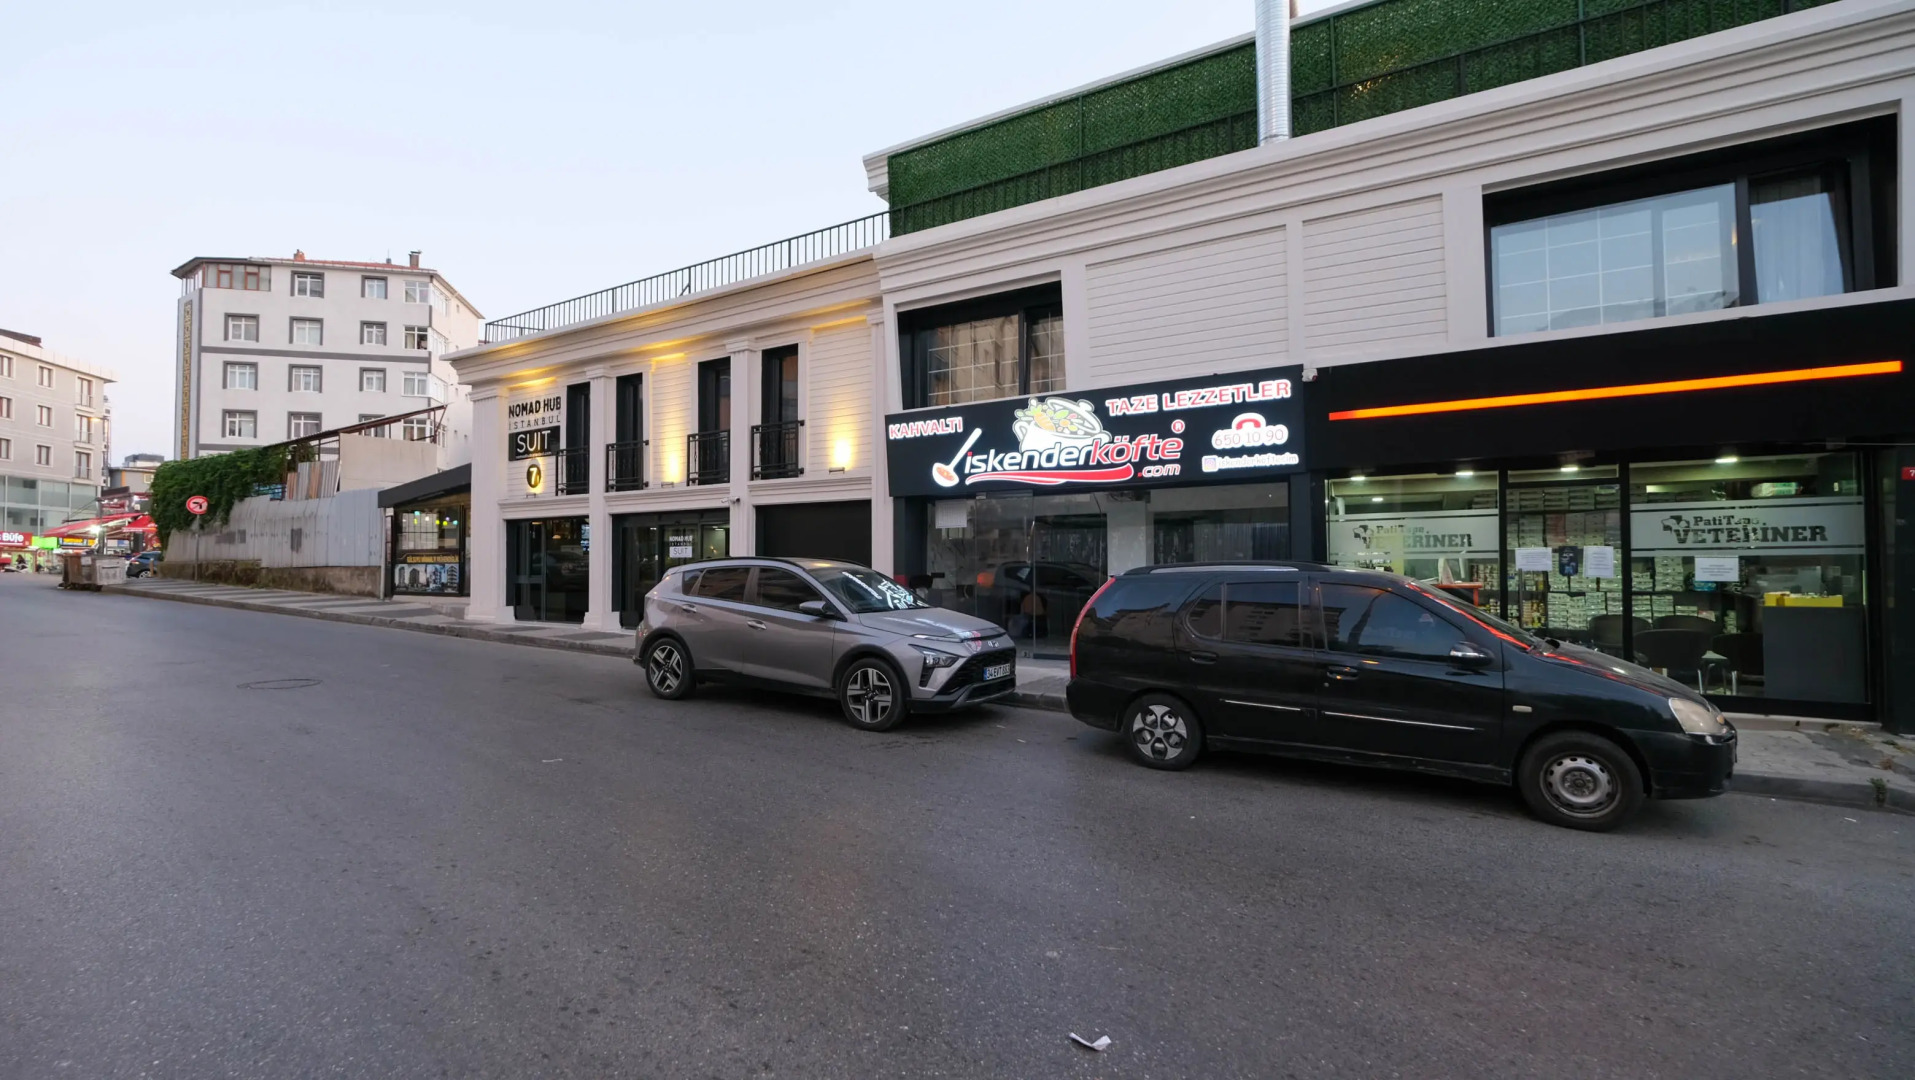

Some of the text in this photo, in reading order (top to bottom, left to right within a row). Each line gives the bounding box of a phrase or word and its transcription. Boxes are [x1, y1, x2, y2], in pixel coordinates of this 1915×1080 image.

[508, 396, 561, 418] NOMAD HUB
[1106, 379, 1292, 416] TAZE LEZZETLER
[889, 416, 963, 440] KAHVALTI
[1214, 428, 1284, 447] 650 10 90
[517, 431, 551, 452] SUIT
[965, 435, 1183, 473] iskenderköfte
[1137, 463, 1181, 479] .com
[2, 532, 25, 543] Büfe
[1361, 530, 1473, 549] VEERİNER
[672, 547, 689, 555] SUIT
